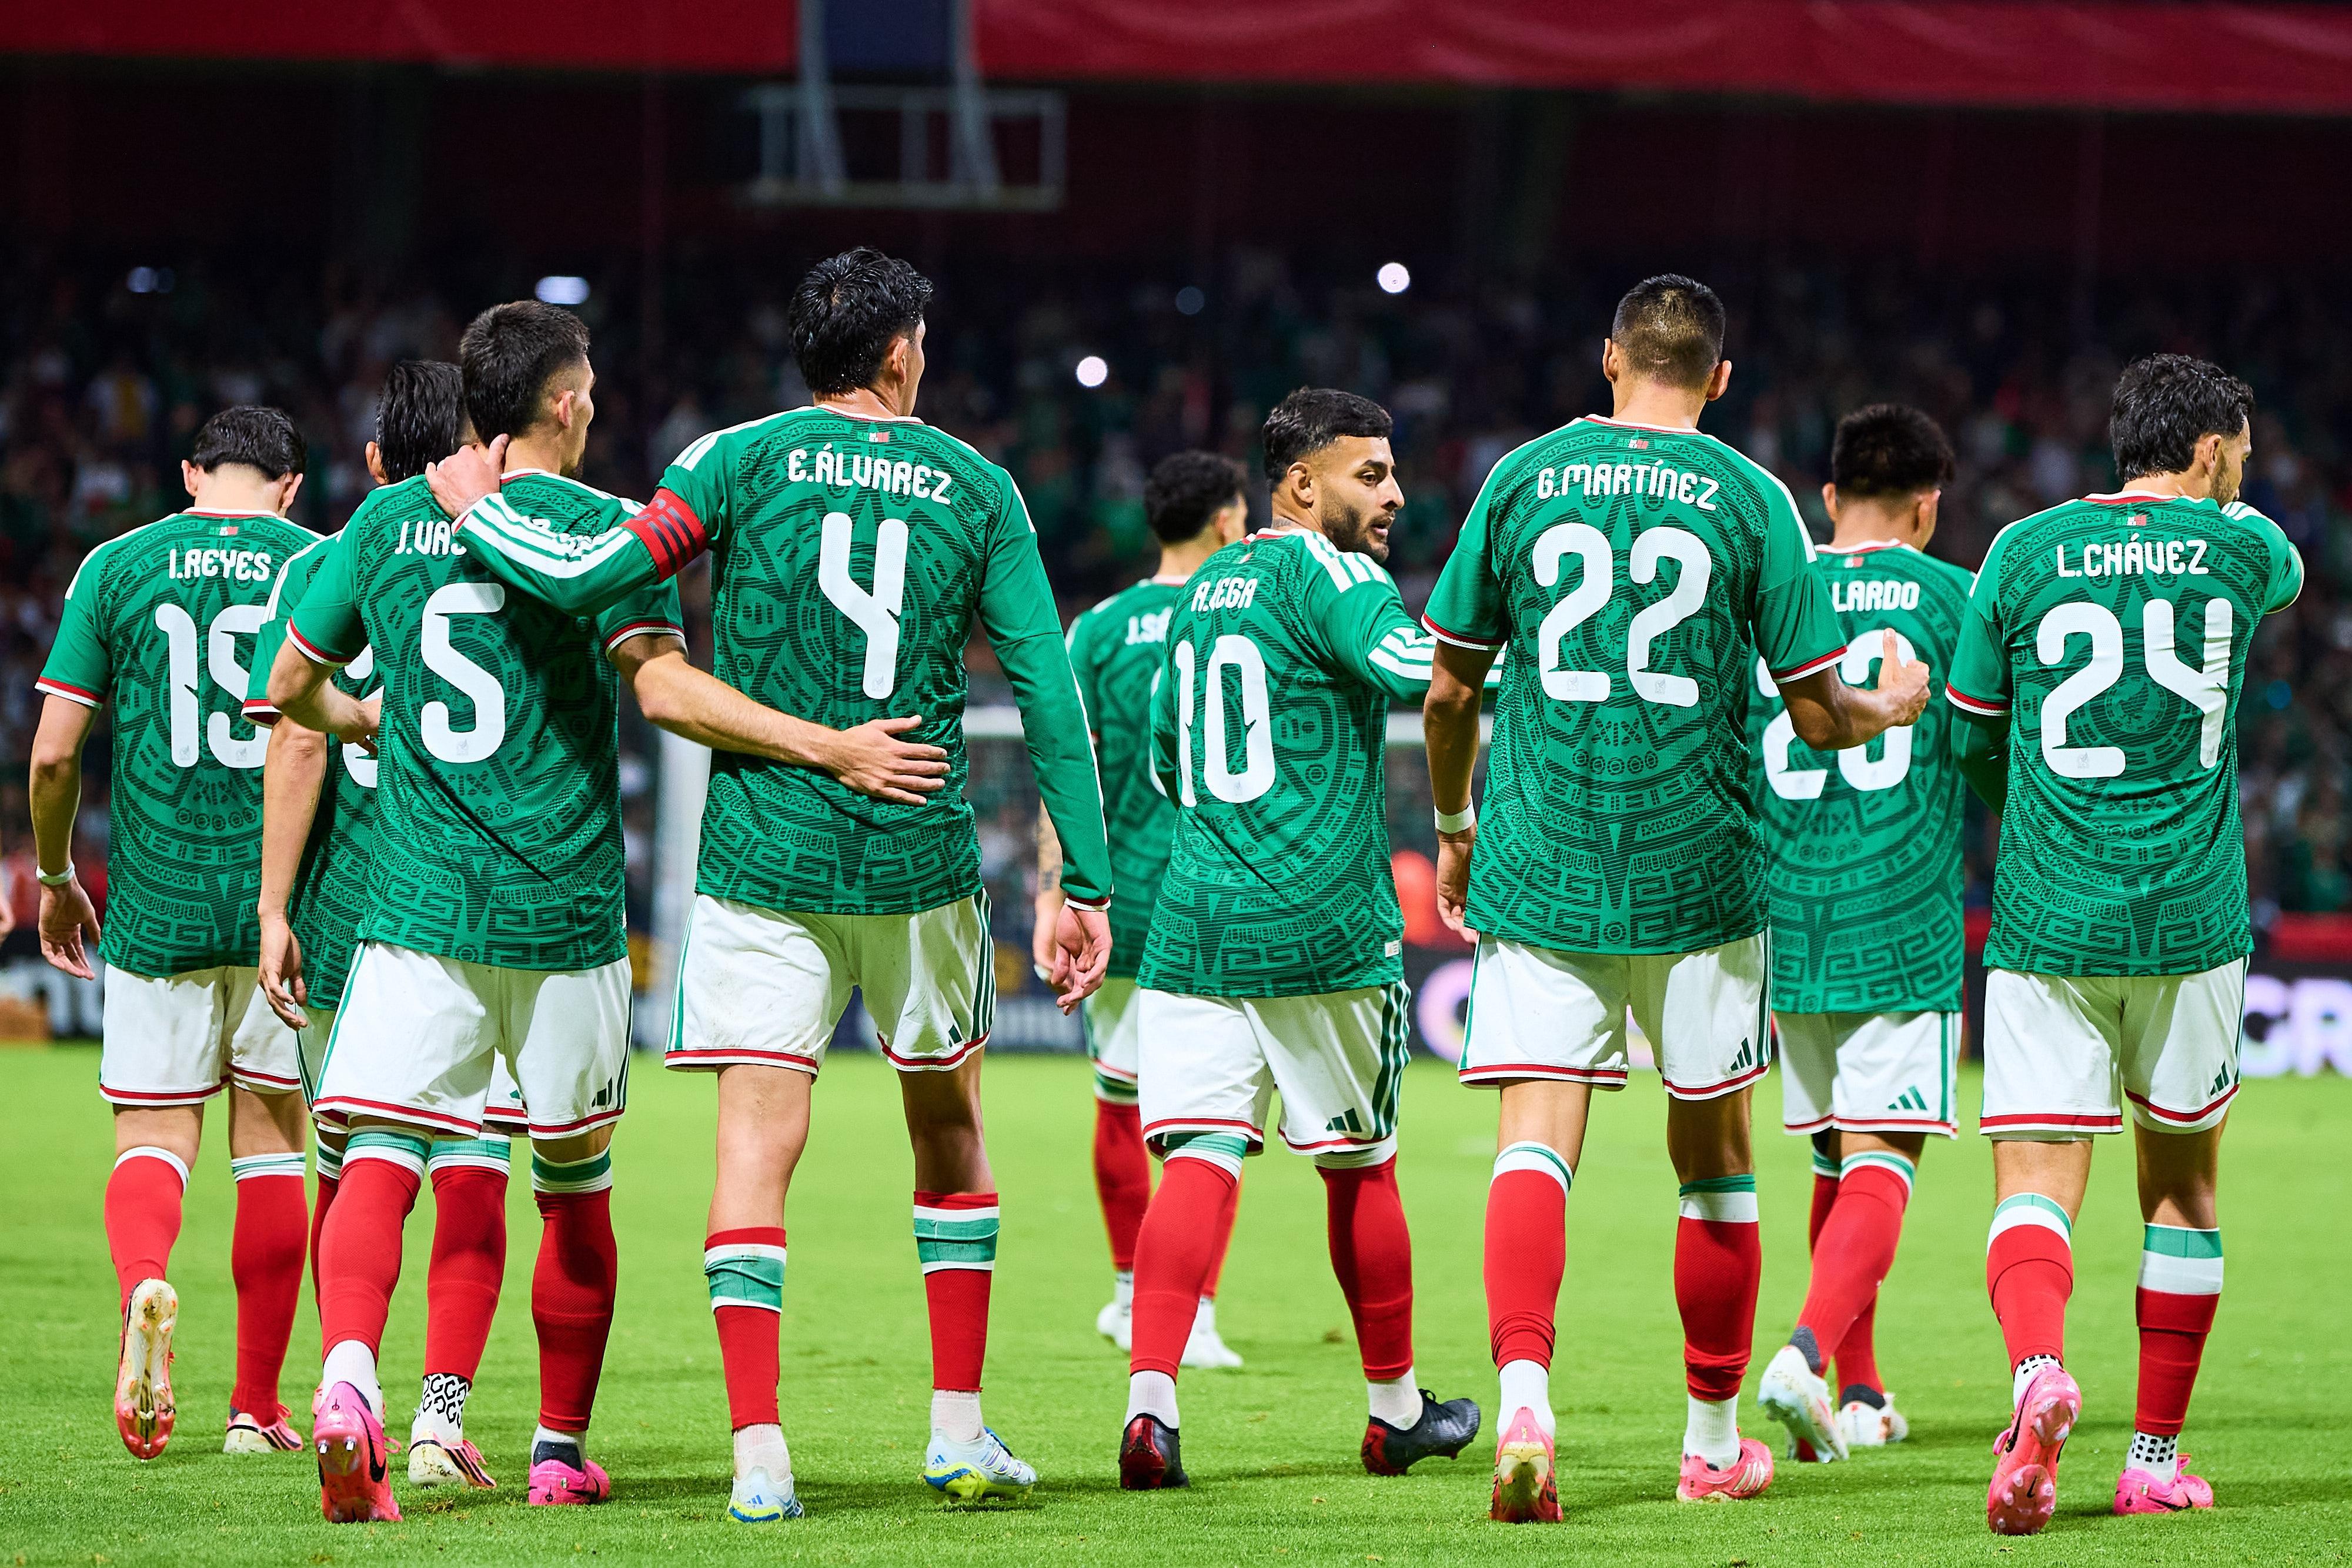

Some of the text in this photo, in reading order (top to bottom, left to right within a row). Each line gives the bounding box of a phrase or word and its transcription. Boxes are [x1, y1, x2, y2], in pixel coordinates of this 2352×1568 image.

[788, 443, 951, 504] E.ÁLVAREZ
[1537, 460, 1720, 511] G.MARTÍNEZ
[2057, 533, 2209, 577] L.CHÁVEZ
[169, 548, 272, 581] I.REYES
[818, 511, 909, 700] 4
[1532, 523, 1712, 707] 22
[1832, 580, 1920, 613] LARDO
[155, 603, 266, 768] 15
[420, 582, 505, 763] 5
[1175, 634, 1276, 808] 10
[2036, 597, 2233, 778] 24
